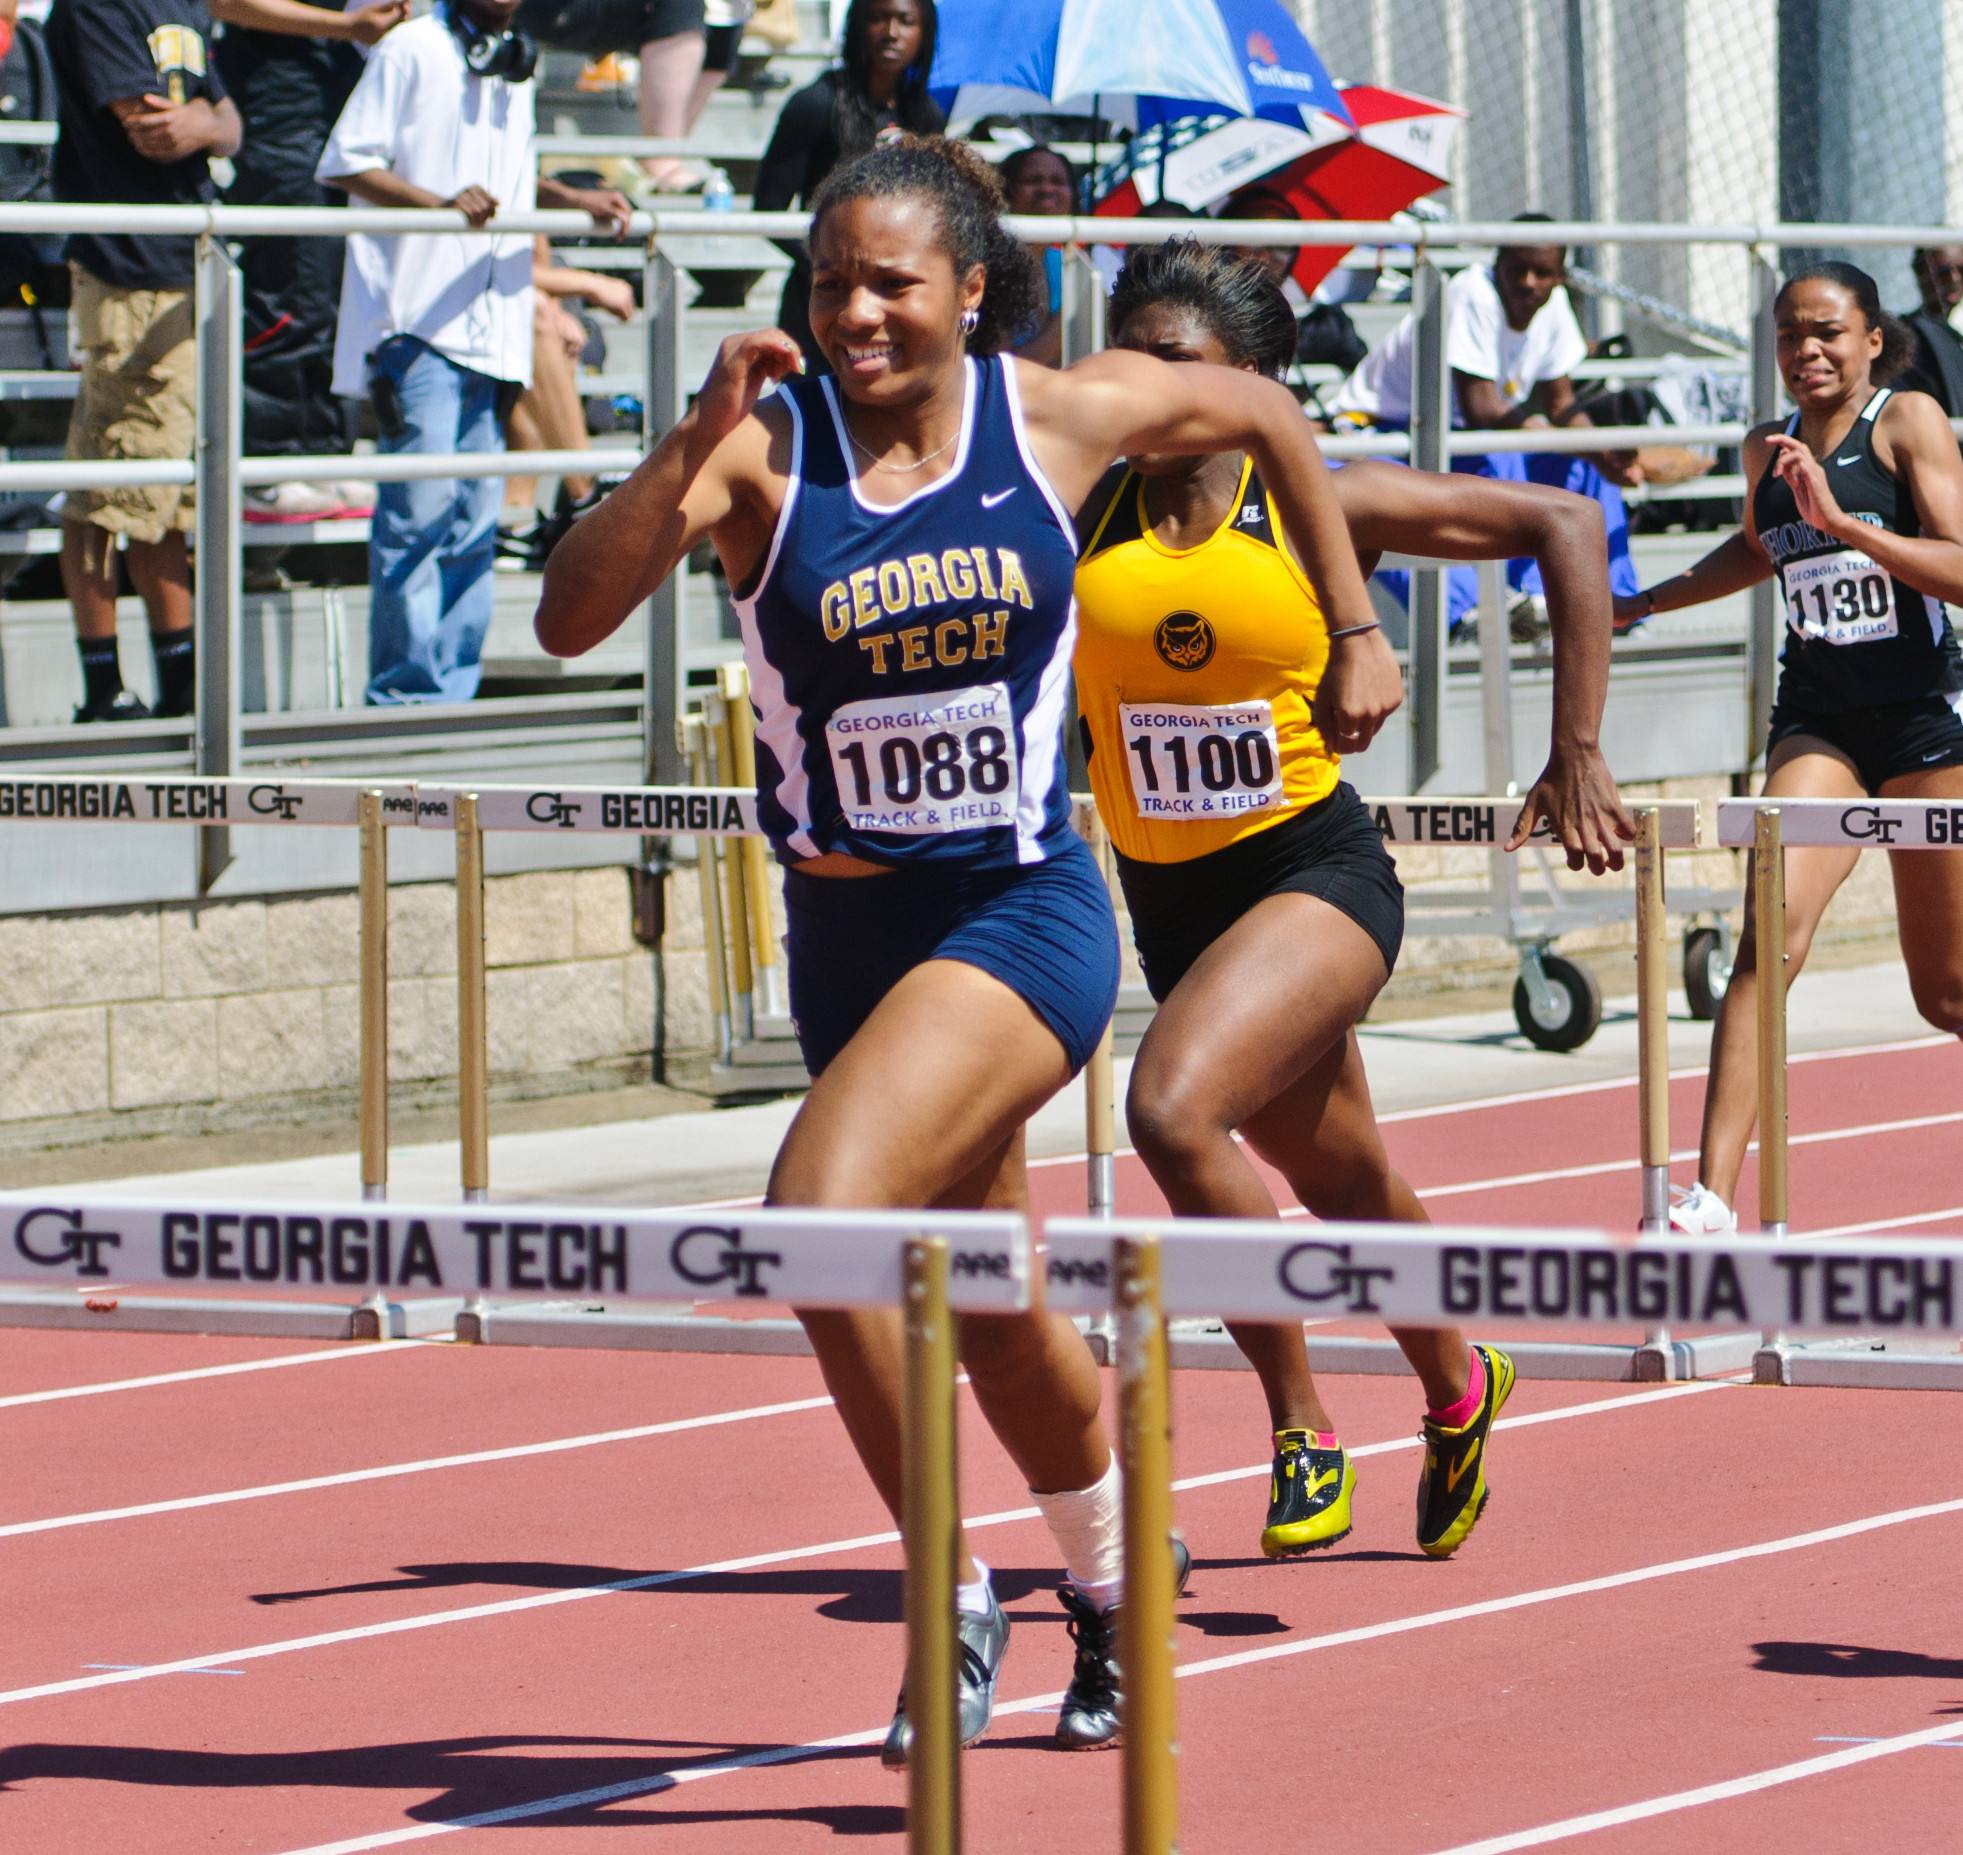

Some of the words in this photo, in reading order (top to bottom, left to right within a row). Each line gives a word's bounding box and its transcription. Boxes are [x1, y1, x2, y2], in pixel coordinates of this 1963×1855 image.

[1789, 565, 1841, 583] GEORGIA
[821, 547, 1034, 642] GEORGIA
[1790, 574, 1889, 630] 1130
[858, 610, 1009, 674] TECH
[1836, 628, 1845, 639] &
[1852, 623, 1886, 637] FIELD
[836, 711, 936, 734] GEORGIA
[944, 701, 996, 723] TECH
[1130, 714, 1210, 728] GEORGIA
[1214, 713, 1260, 728] TECH
[837, 726, 1010, 806] 1088
[1130, 730, 1274, 793] 1100
[0, 783, 135, 818] GEORGIA
[146, 784, 227, 819] TECH
[602, 794, 745, 830] GEORGIA
[853, 810, 918, 828] TRACK
[926, 810, 940, 824] &
[950, 802, 1001, 822] FIELD
[1143, 797, 1194, 812] TRACK
[1202, 798, 1214, 811] &
[1222, 793, 1270, 810] FIELD
[1406, 806, 1495, 842] TECH
[162, 1212, 442, 1287] GEORGIA
[463, 1221, 627, 1293] TECH
[1440, 1246, 1749, 1323] GEORGIA
[1773, 1254, 1954, 1327] TECH
